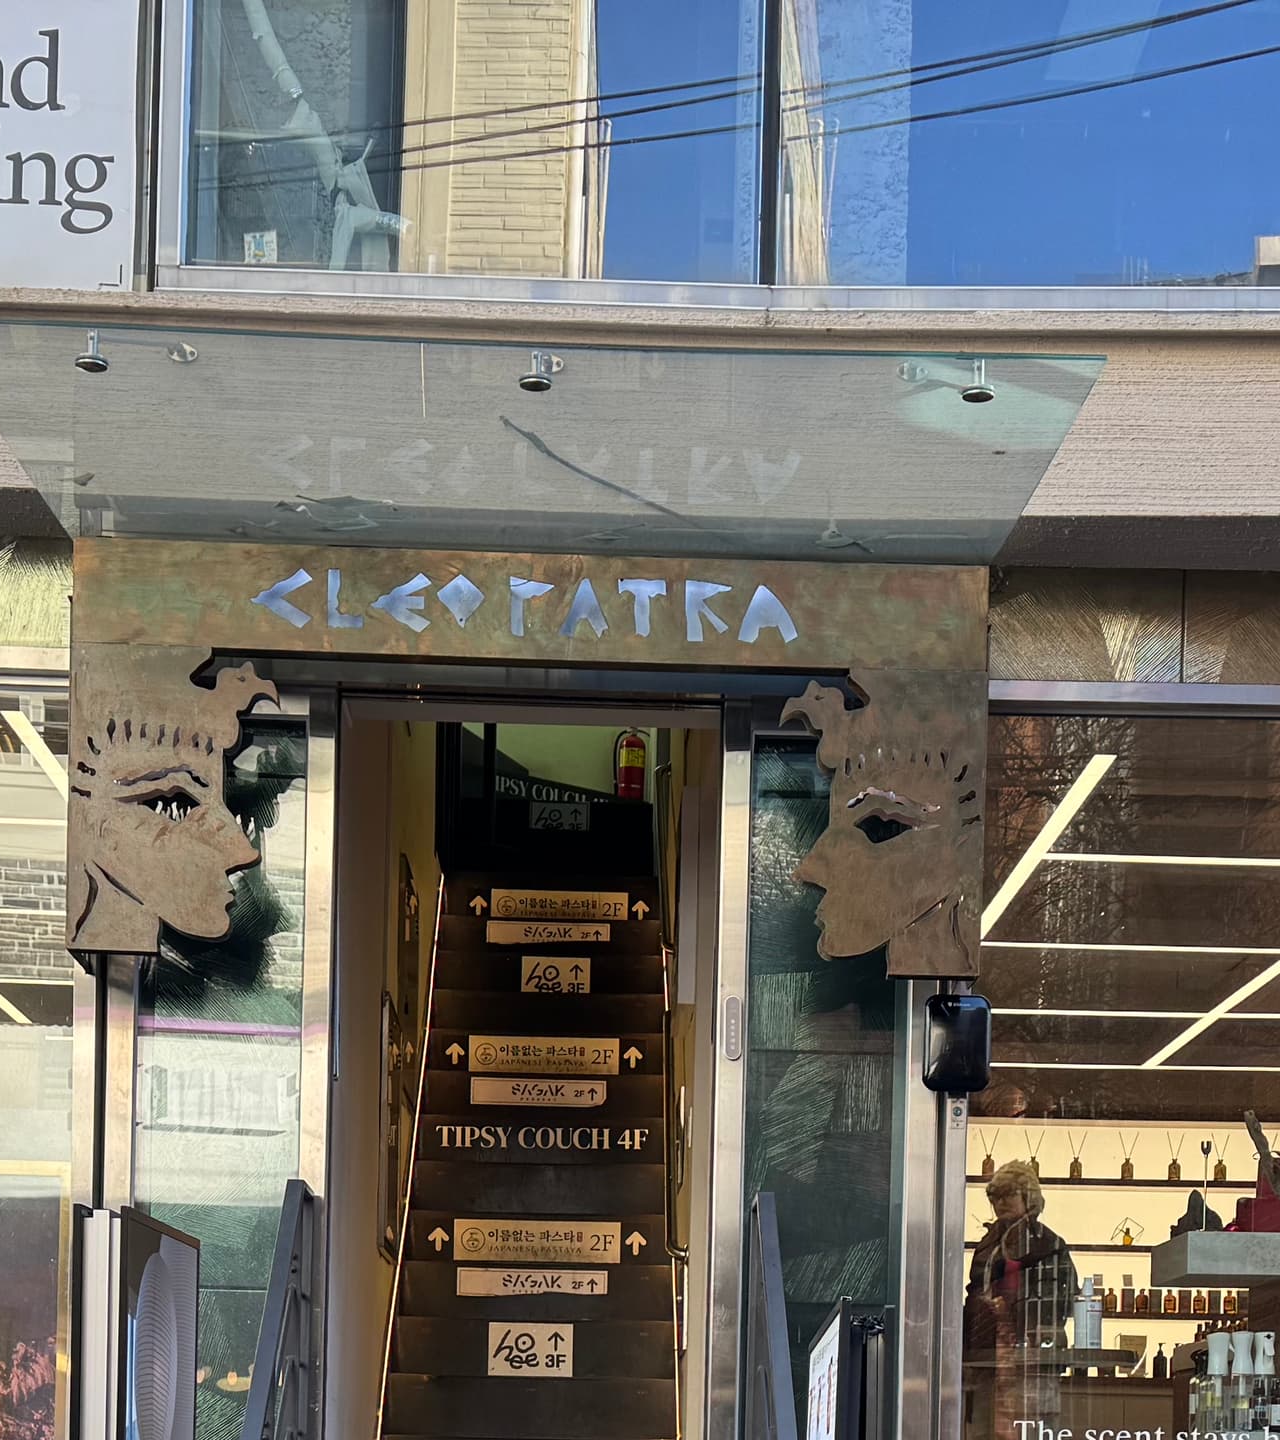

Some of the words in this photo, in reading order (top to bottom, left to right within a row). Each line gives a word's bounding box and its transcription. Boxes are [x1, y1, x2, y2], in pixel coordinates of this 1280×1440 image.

[252, 567, 801, 644] CLEOPATRA
[495, 775, 529, 798] IPSY
[518, 897, 560, 910] 이름없는
[561, 898, 592, 910] 파스타
[602, 901, 624, 917] 2F
[580, 931, 592, 939] 2F
[499, 1045, 544, 1057] 이름없는
[546, 1046, 579, 1058] 파스타
[590, 1049, 614, 1065] 2F
[511, 1083, 566, 1097] SAGAK
[573, 1089, 585, 1098] 2F
[436, 1126, 512, 1150] TIPSY
[518, 1127, 610, 1150] COUCH
[616, 1128, 650, 1151] 4F
[487, 1229, 537, 1245] 이름없는
[539, 1230, 577, 1245] 파스타
[589, 1233, 615, 1252] 2F
[501, 1274, 562, 1289] SAGAK
[570, 1280, 584, 1290] 2F
[544, 1354, 566, 1369] 3F
